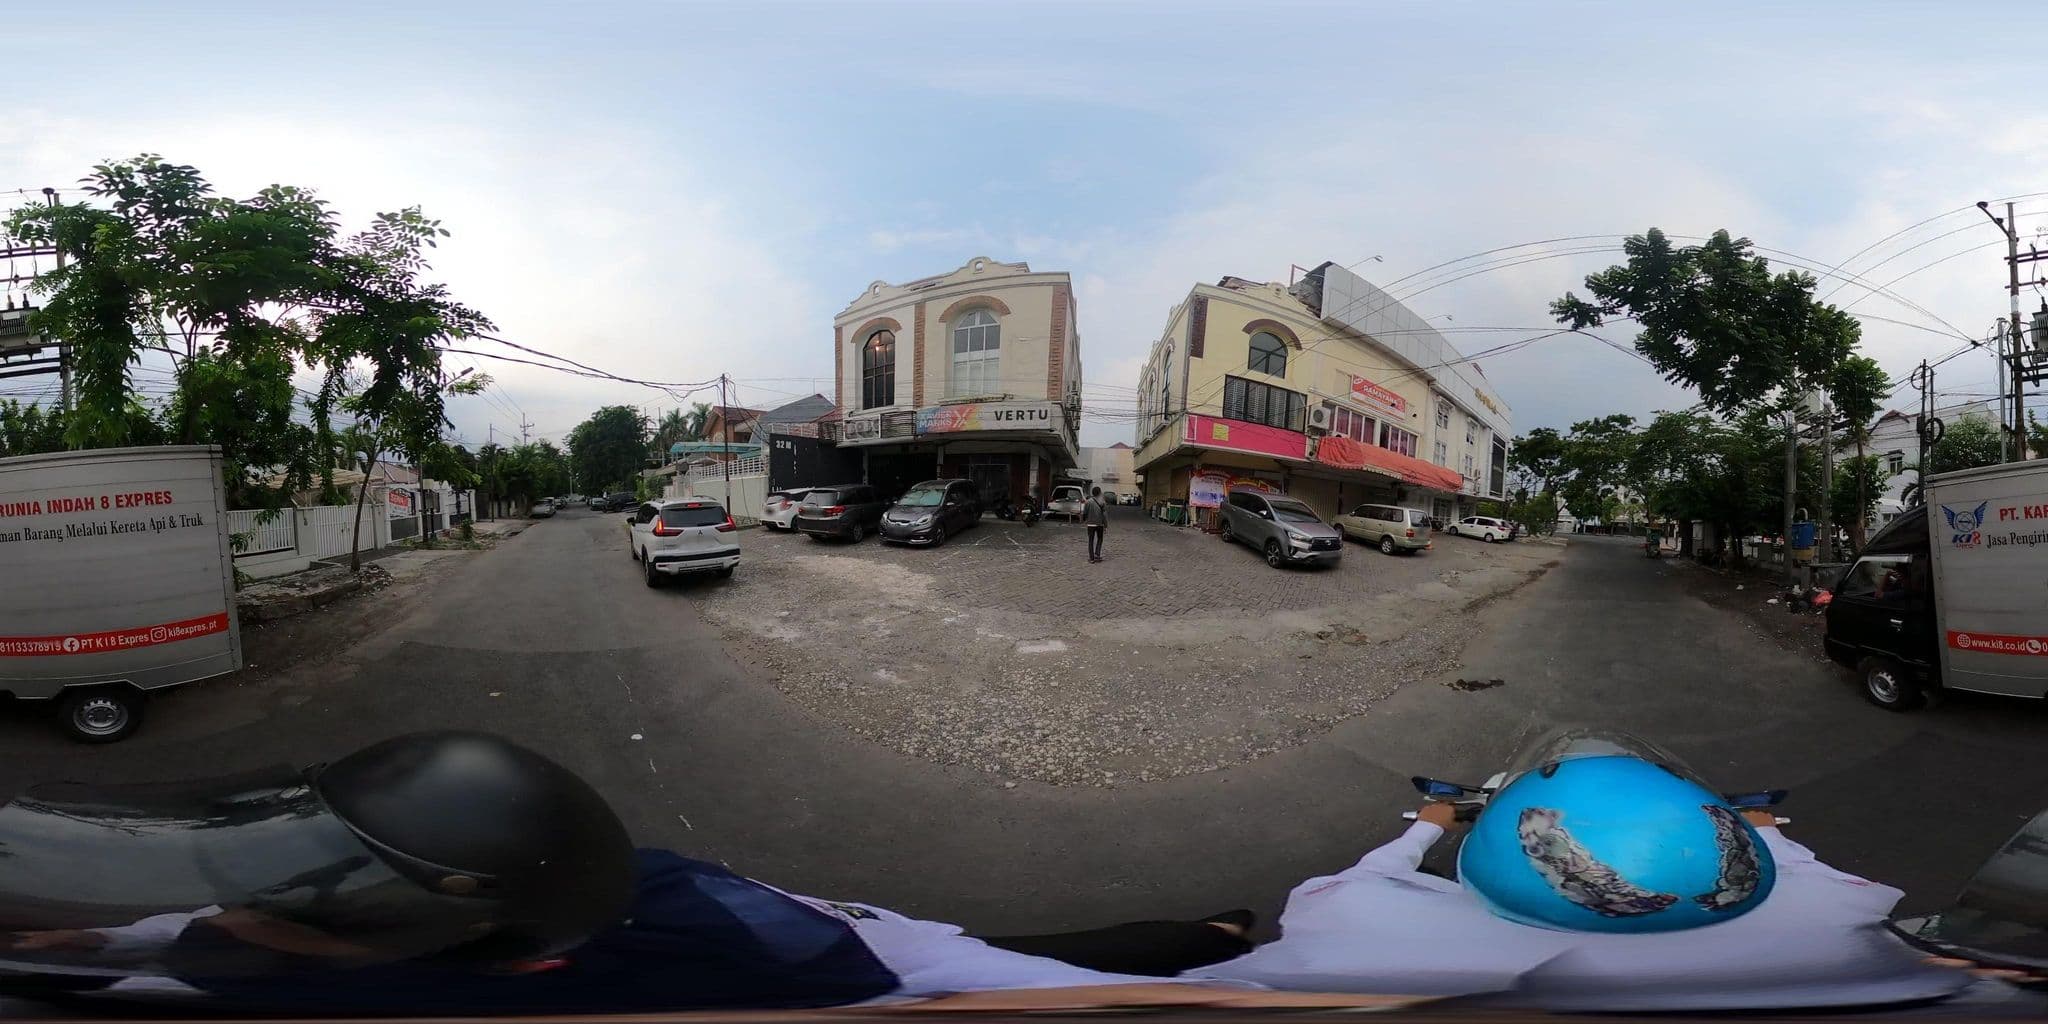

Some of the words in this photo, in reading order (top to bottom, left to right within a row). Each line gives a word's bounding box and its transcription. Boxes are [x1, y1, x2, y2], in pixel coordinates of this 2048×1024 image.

[994, 409, 1048, 421] VERTU
[775, 440, 785, 449] 32
[47, 497, 95, 514] INDAH
[101, 496, 110, 509] 8
[115, 491, 173, 509] EXPRES
[1999, 507, 2019, 521] PT.
[23, 527, 64, 543] Barang
[65, 522, 108, 538] Melalui
[110, 520, 146, 534] Kereta
[149, 517, 166, 534] Api
[169, 515, 177, 529] &
[179, 512, 204, 528] Truk
[1986, 534, 2007, 549] Jasa
[2009, 530, 2048, 548] Pengiri
[80, 638, 94, 649] PT
[96, 637, 104, 648] K
[110, 636, 117, 646] 8
[118, 634, 149, 646] Expres
[1971, 639, 2025, 652] www.ki8.co.id
